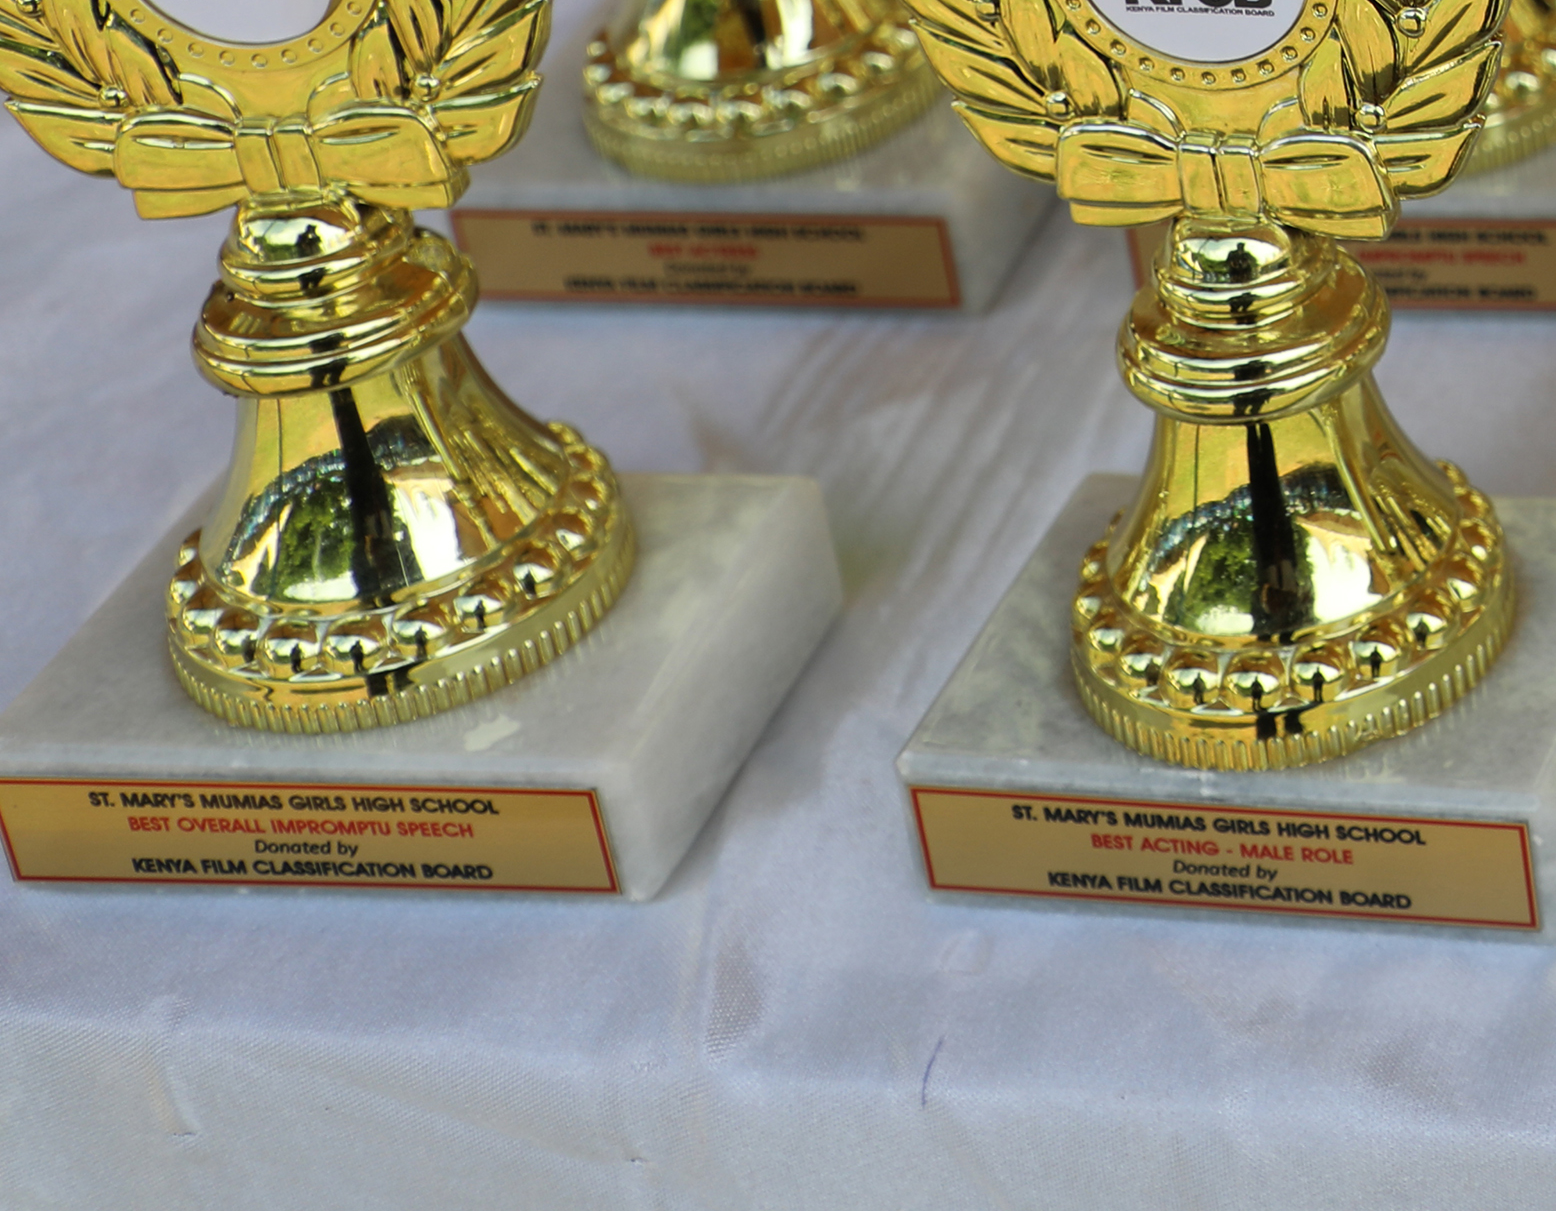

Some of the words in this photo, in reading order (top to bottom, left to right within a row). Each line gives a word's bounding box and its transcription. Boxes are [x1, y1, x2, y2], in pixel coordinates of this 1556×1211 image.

[1177, 7, 1243, 15] CLASSIFICATION
[88, 791, 115, 809] ST.
[122, 792, 196, 810] MARY'S
[200, 793, 284, 811] MUMIAS
[291, 795, 346, 813] GIRLS
[353, 797, 404, 813] HIGH
[410, 798, 500, 815] SCHOOL
[128, 816, 171, 833] BEST
[177, 817, 266, 835] OVERALL
[270, 819, 392, 837] IMPROMPTU
[397, 820, 474, 839] SPEECH
[1011, 805, 1037, 822] ST.
[1044, 806, 1118, 826] MARY'S
[1124, 811, 1207, 831] MUMIAS
[1212, 816, 1270, 836] GIRLS
[1277, 820, 1330, 840] HIGH
[1335, 823, 1426, 846] SCHOOL
[254, 839, 330, 856] Donated
[336, 841, 358, 858] by
[1090, 833, 1134, 851] BEST
[1140, 836, 1220, 856] ACTING
[1239, 842, 1294, 860] MALE
[1300, 846, 1354, 865] ROLE
[132, 858, 196, 875] KENYA
[201, 859, 247, 875] FILM
[252, 861, 416, 879] CLASSIFICATION
[422, 863, 494, 881] BOARD
[1172, 859, 1249, 878] Donated
[1254, 864, 1278, 882] by
[1047, 872, 1113, 891] KENYA
[1117, 876, 1163, 894] FILM
[1169, 878, 1333, 906] CLASSIFICATION
[1340, 890, 1412, 910] BOARD
